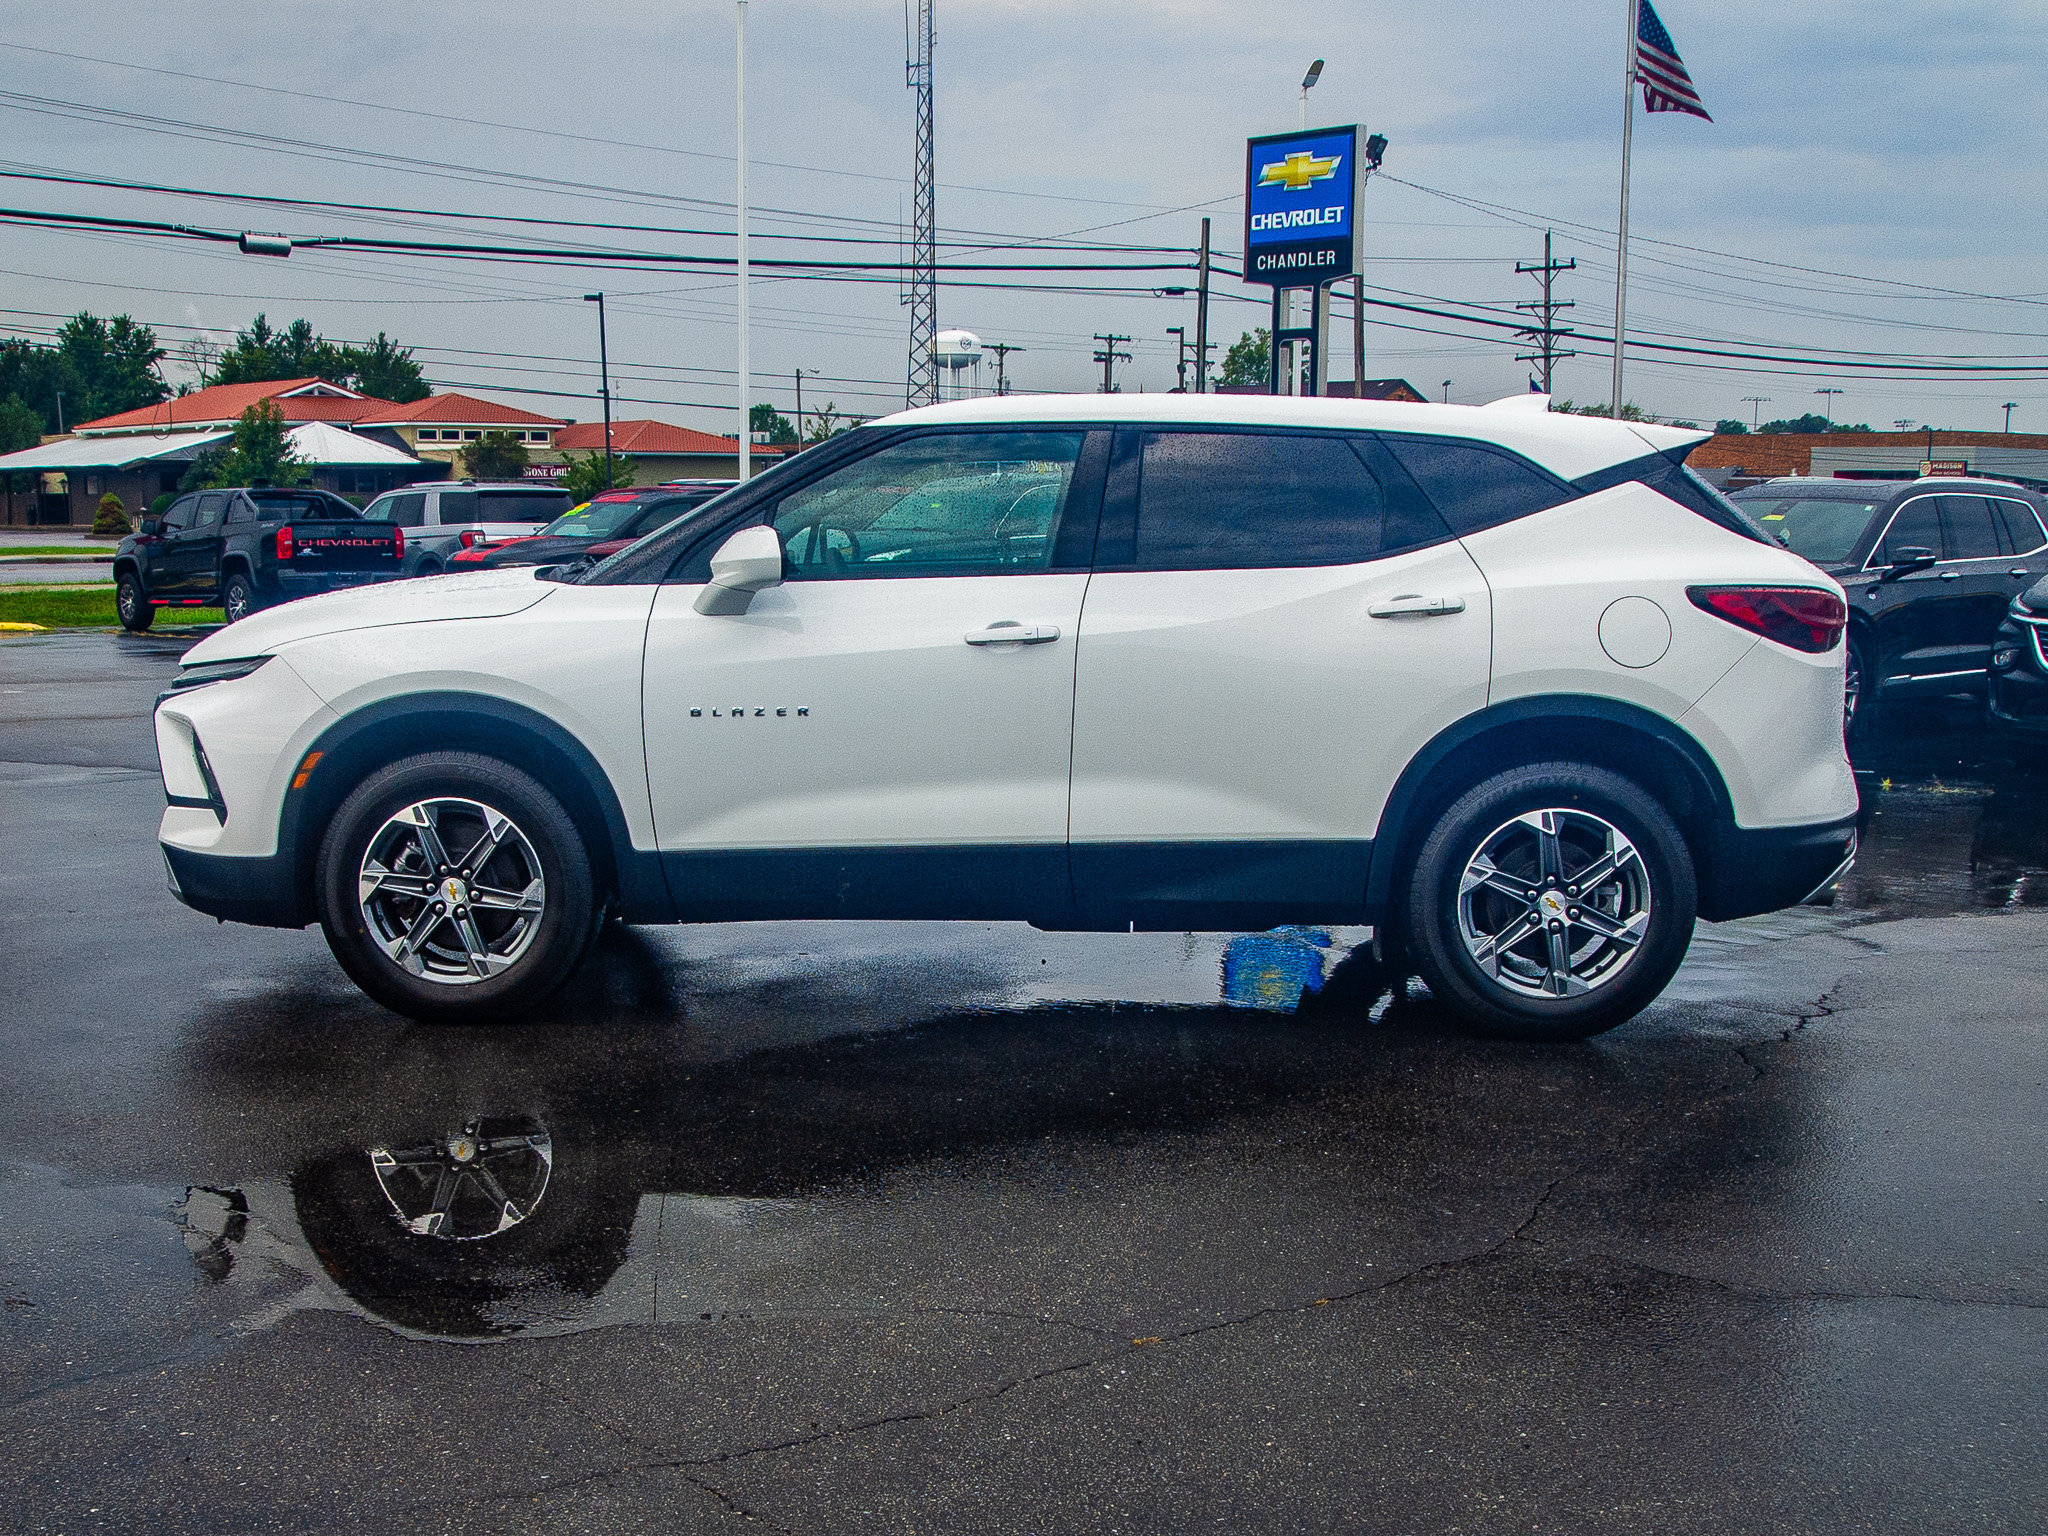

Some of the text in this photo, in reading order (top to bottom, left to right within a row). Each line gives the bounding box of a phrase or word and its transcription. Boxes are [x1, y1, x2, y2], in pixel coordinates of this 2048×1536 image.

[1251, 206, 1345, 231] CHEVROLET
[1257, 250, 1336, 270] CHANDLER
[523, 466, 571, 477] STONE GRIL
[298, 539, 390, 547] CHEVROLET
[689, 706, 809, 717] BLAZER
